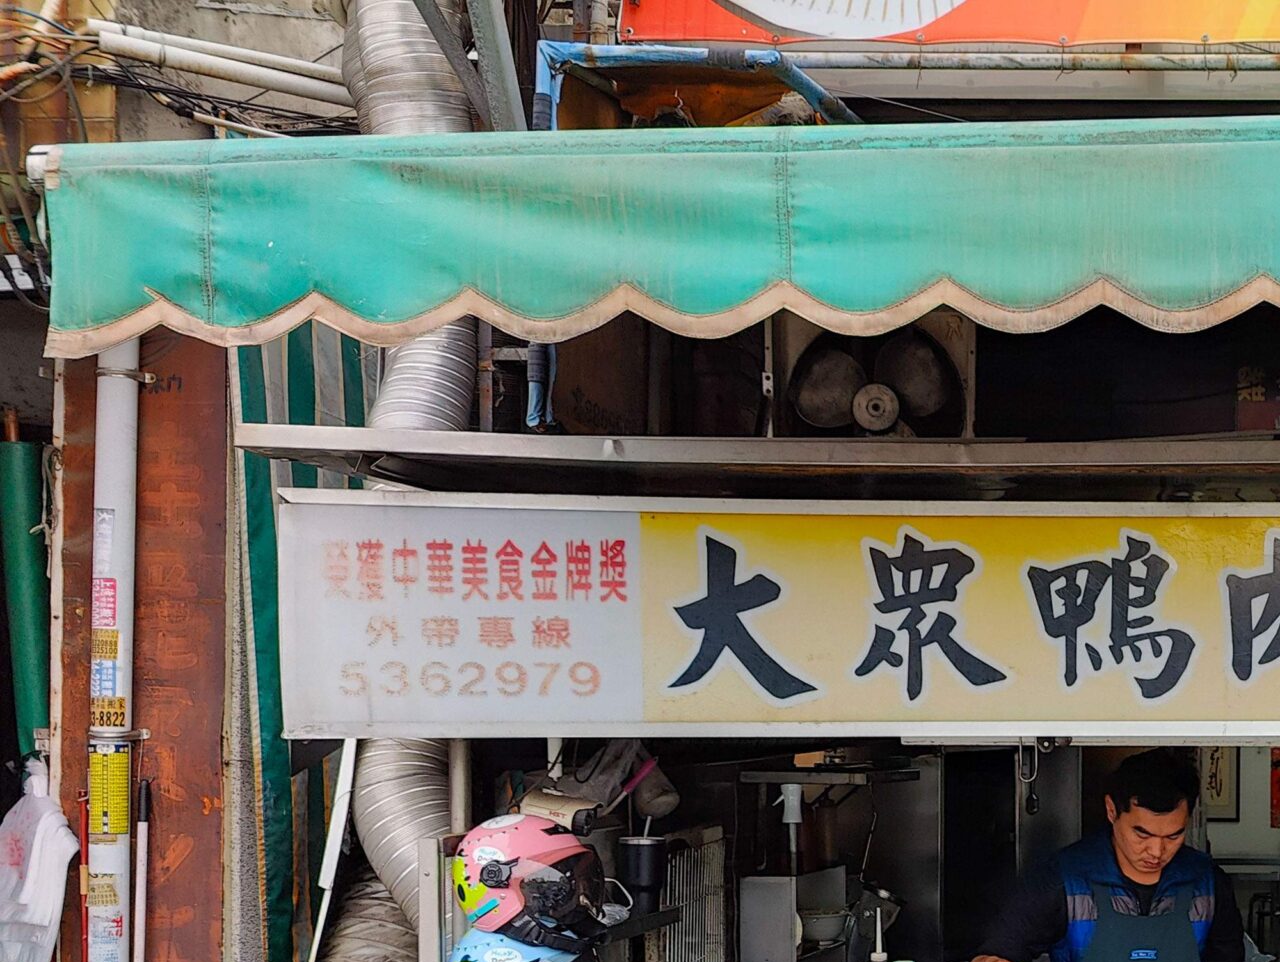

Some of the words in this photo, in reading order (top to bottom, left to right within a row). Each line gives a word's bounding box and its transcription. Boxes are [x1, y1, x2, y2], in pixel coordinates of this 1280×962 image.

[366, 614, 574, 650] 外帶專線
[338, 660, 602, 698] 5362979
